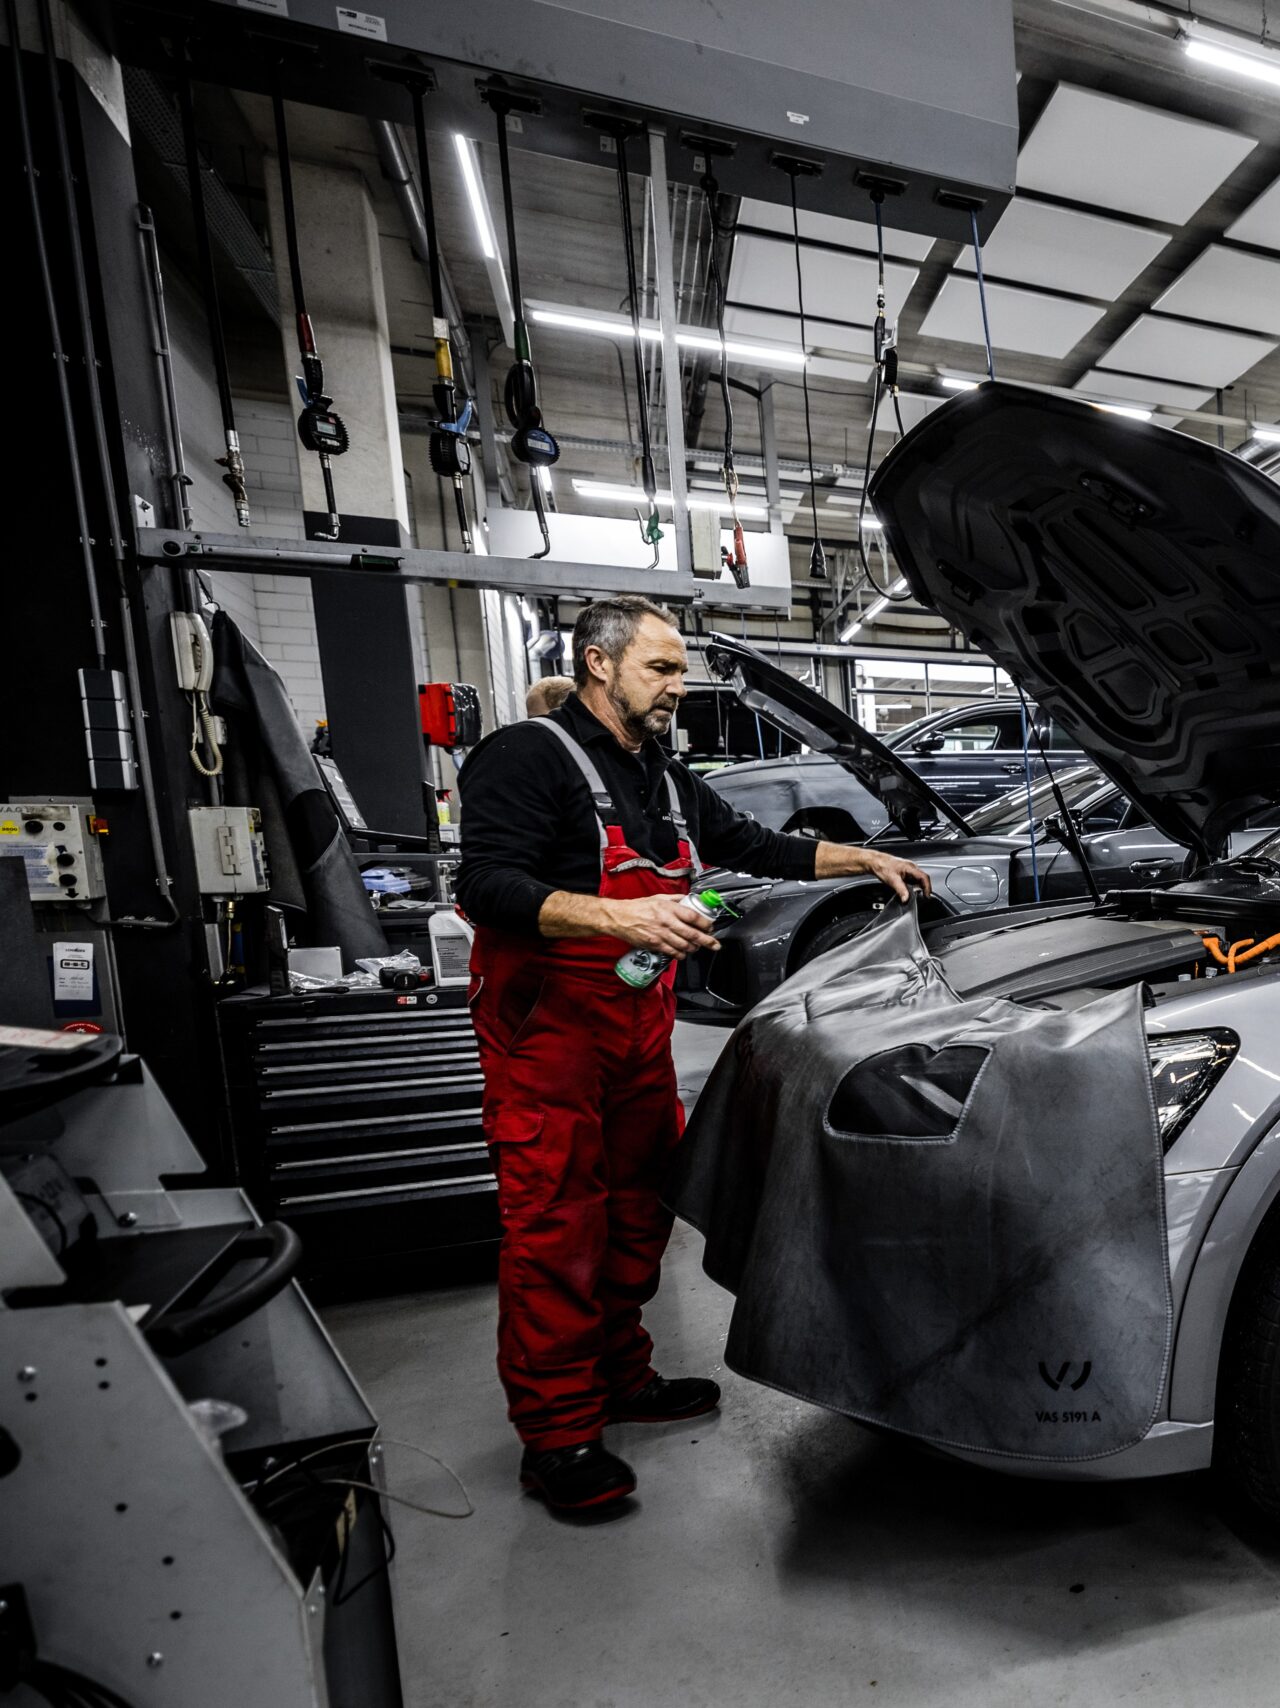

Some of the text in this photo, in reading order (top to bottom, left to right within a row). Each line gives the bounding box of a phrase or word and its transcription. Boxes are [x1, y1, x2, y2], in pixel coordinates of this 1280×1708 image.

[1035, 1411, 1102, 1423] VAS 5191 A
